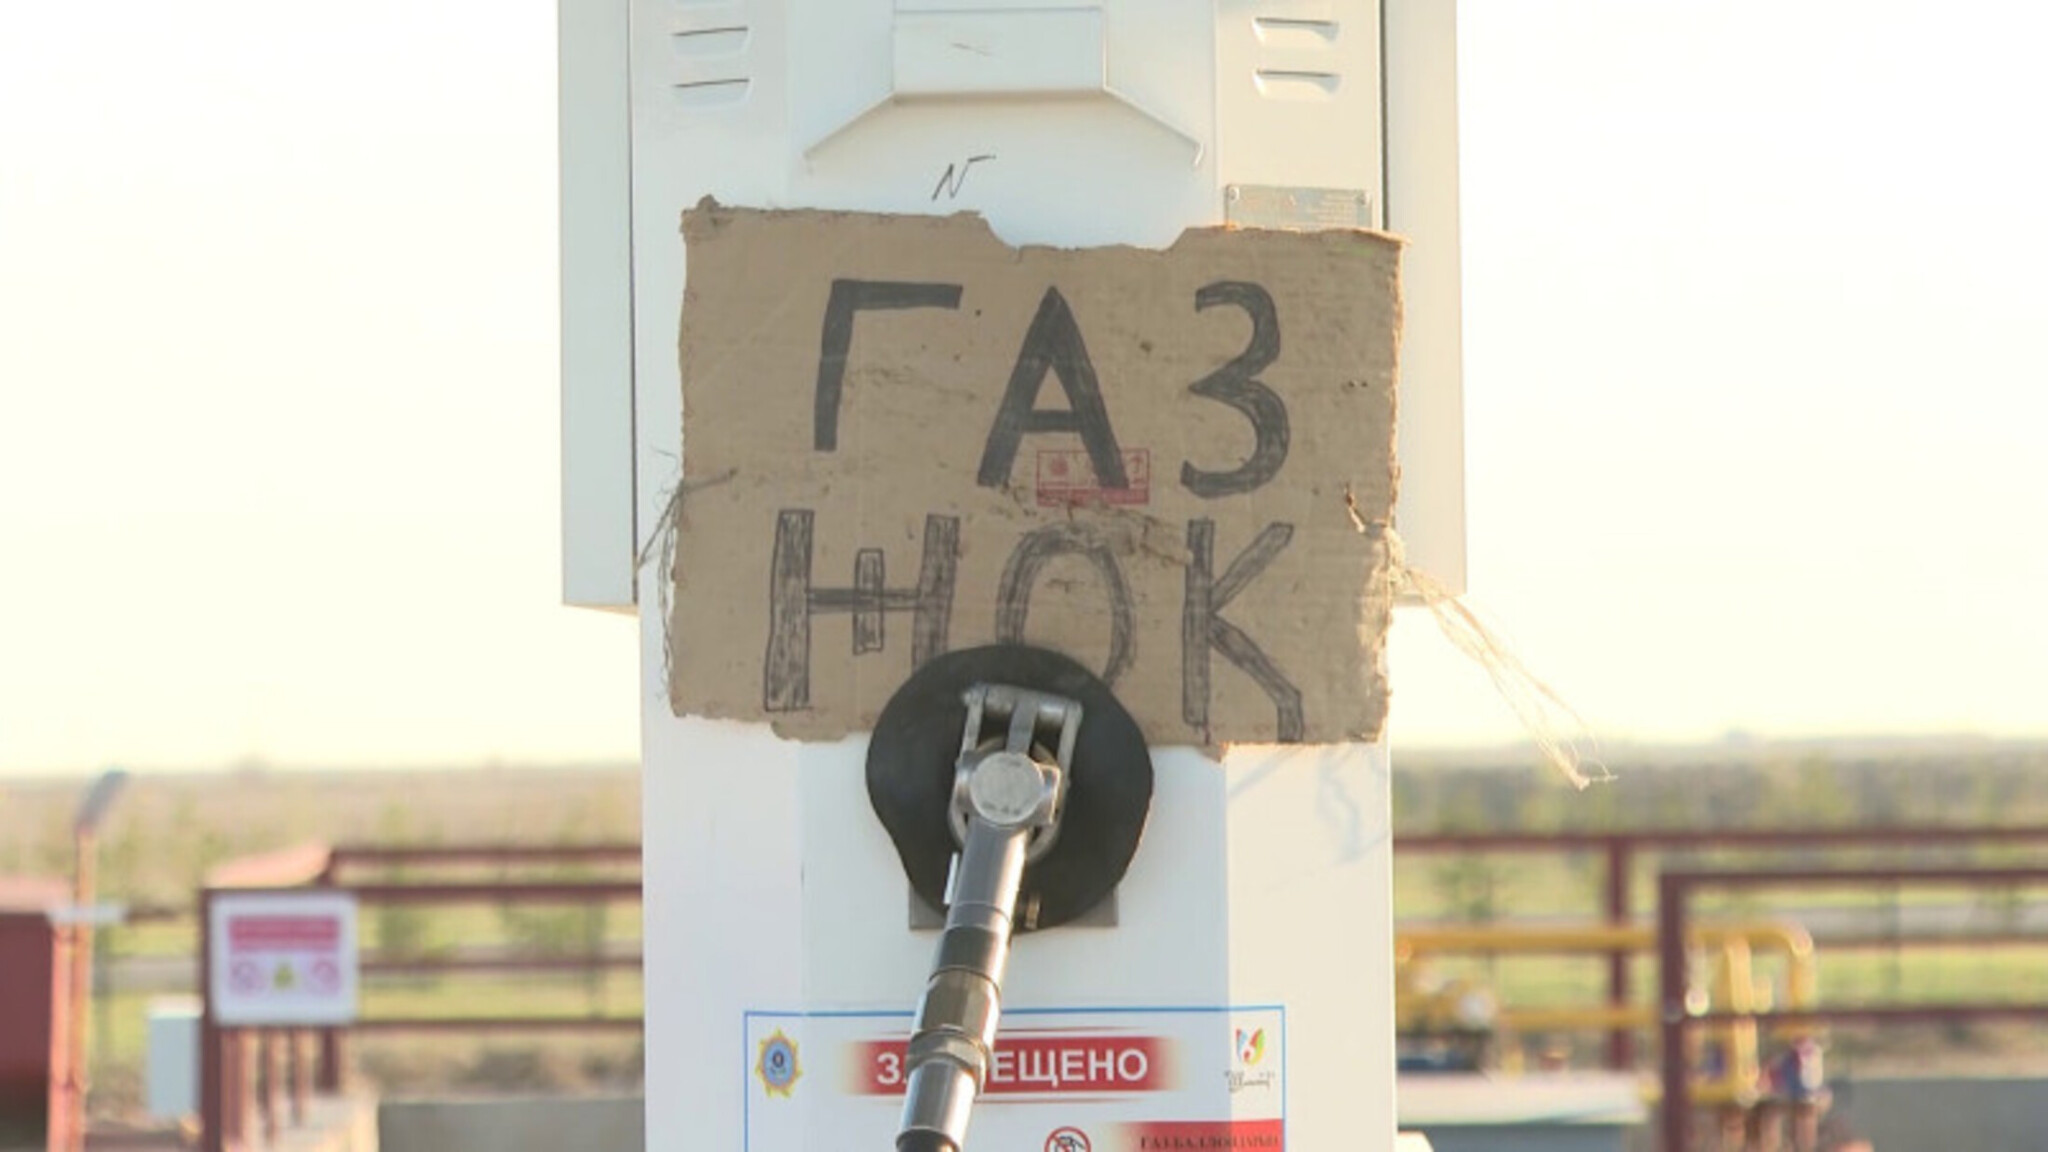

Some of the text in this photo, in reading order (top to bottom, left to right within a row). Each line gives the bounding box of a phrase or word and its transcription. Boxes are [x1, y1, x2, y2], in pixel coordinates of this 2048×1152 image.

[813, 278, 1292, 498] ГАЗ
[763, 508, 1304, 742] ЖОК
[876, 1048, 1148, 1088] ЗЕЩЕНО
